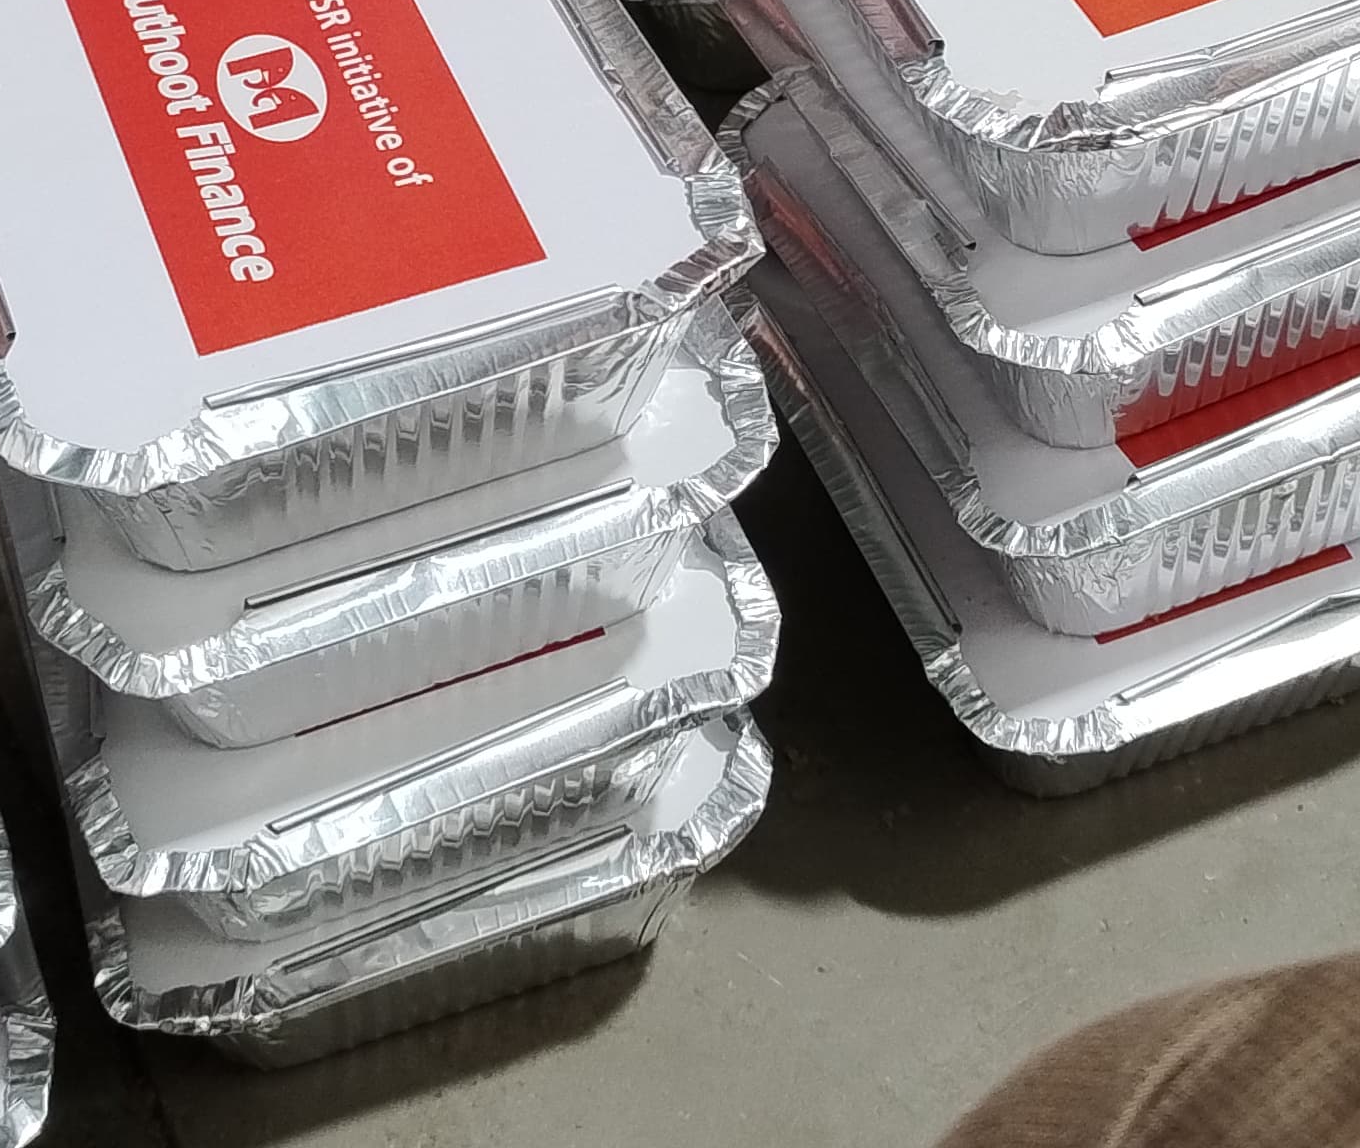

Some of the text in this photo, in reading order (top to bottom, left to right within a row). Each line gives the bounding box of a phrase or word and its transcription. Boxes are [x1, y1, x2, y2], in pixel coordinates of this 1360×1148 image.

[326, 30, 403, 152] initiative
[386, 156, 434, 187] of
[176, 121, 275, 283] Finance
